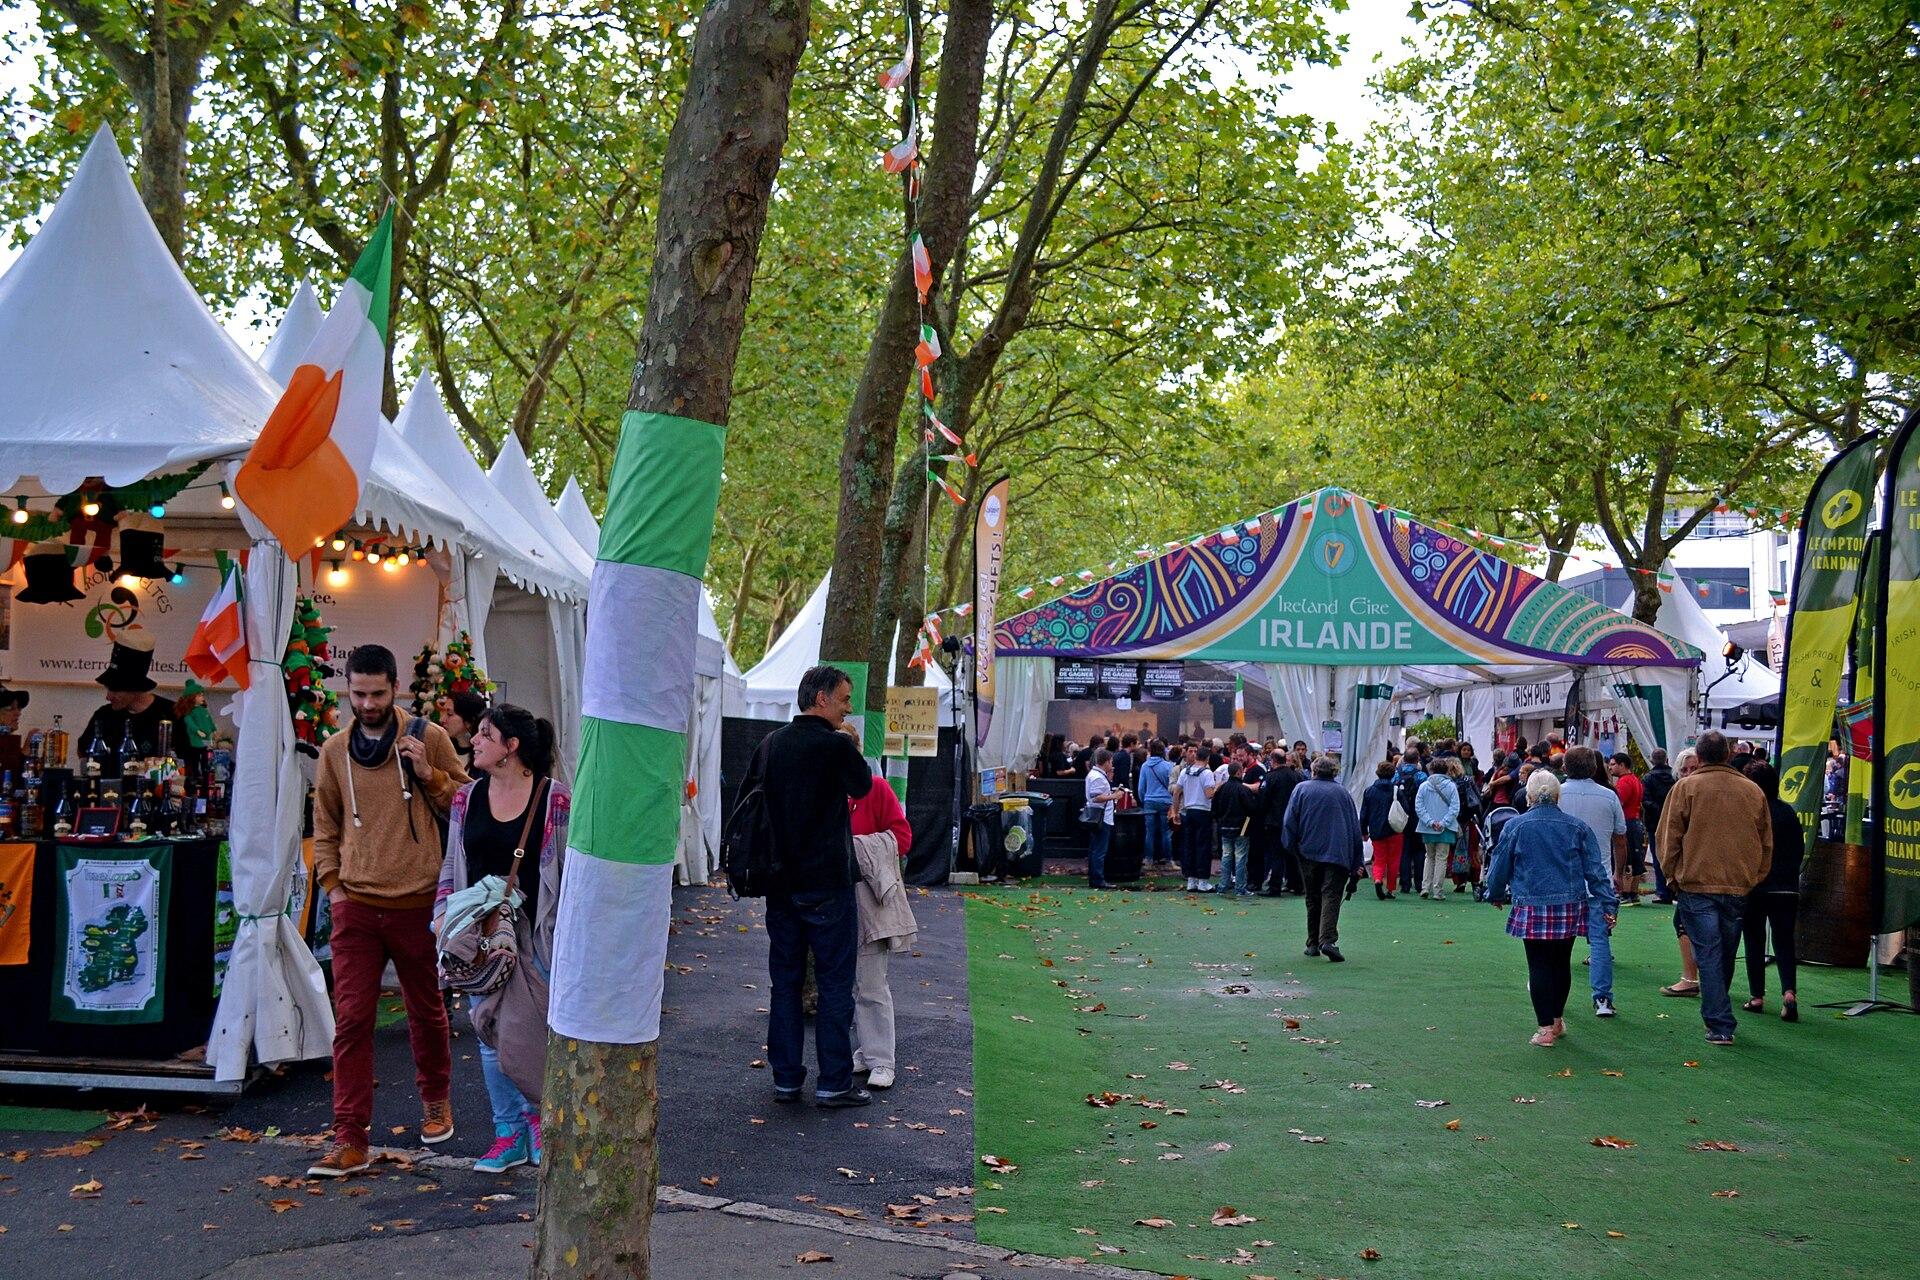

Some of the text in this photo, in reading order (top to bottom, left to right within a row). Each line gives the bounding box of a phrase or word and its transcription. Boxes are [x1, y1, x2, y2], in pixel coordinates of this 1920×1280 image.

[1900, 490, 1918, 507] LE
[1278, 594, 1339, 615] Ireland
[1259, 618, 1413, 650] IRLANDE
[1810, 668, 1822, 689] &
[1512, 682, 1551, 709] IRISH PUB
[1891, 818, 1920, 837] COMP
